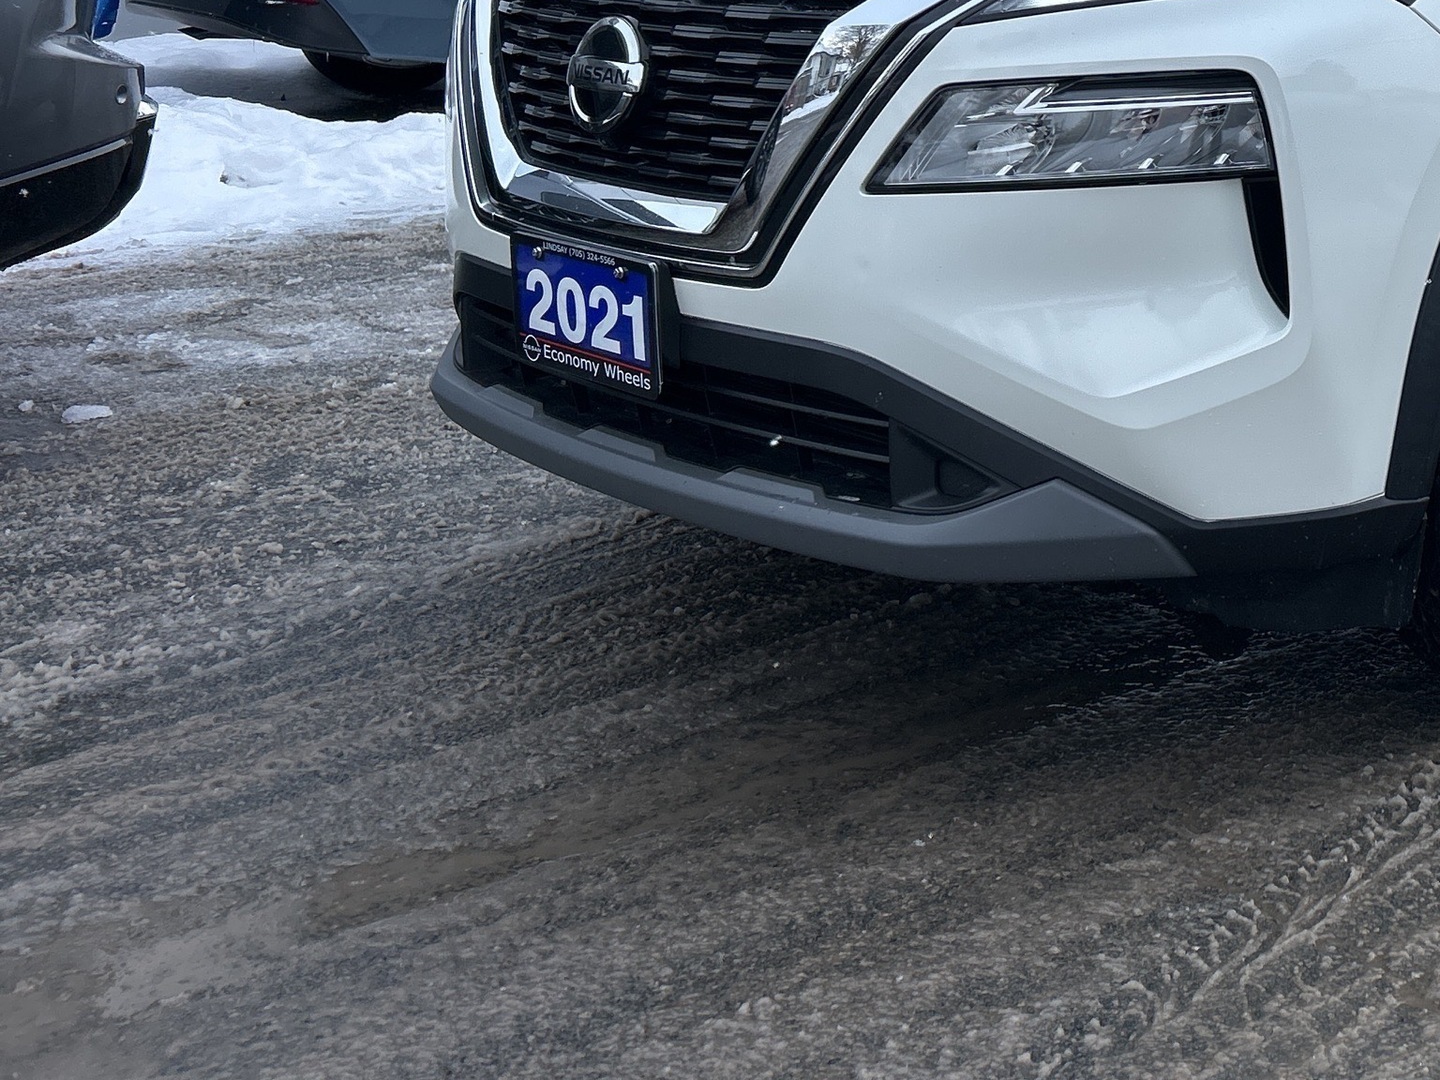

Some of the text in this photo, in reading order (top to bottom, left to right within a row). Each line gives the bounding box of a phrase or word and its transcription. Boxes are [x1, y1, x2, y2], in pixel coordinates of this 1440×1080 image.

[574, 62, 630, 85] NISSAN
[542, 241, 568, 254] LINDSAY
[526, 268, 646, 361] 2021
[544, 344, 651, 390] Economy Wheels
